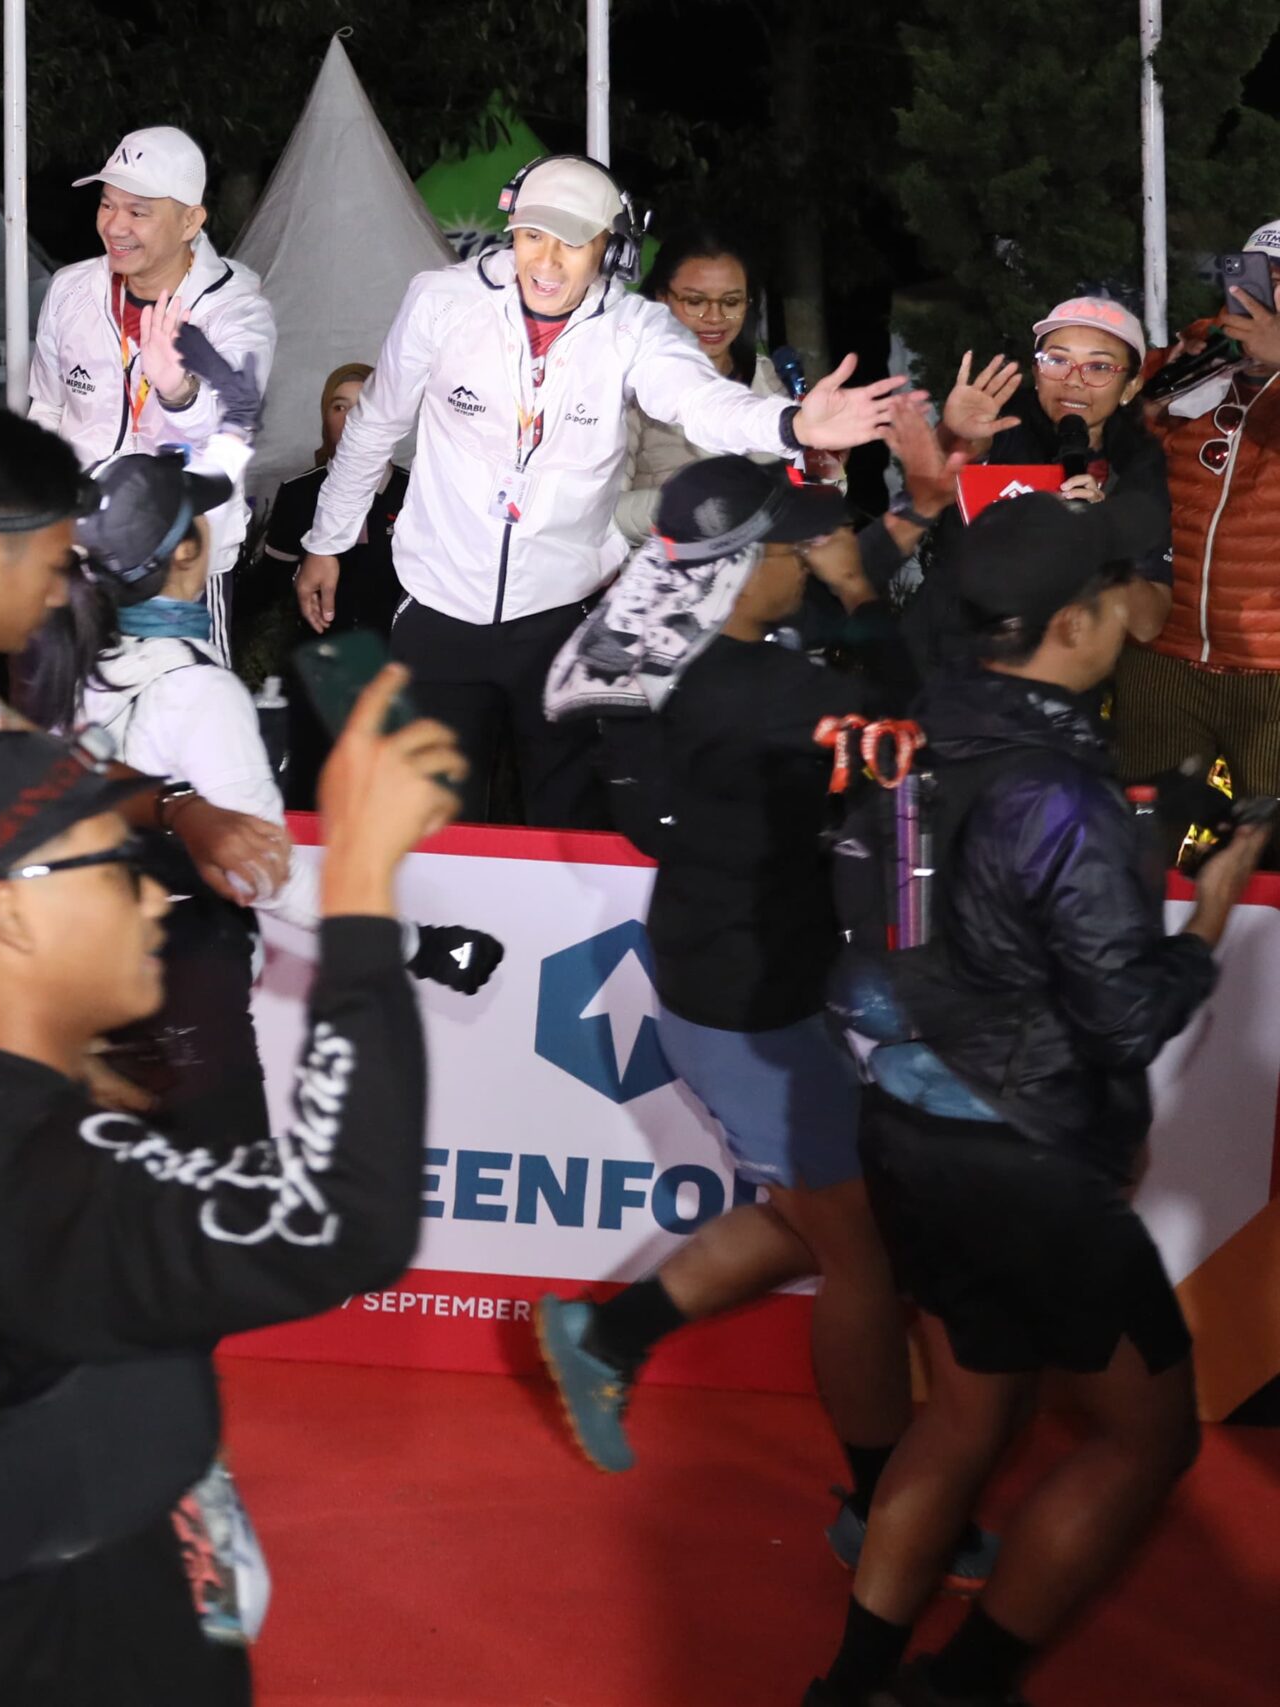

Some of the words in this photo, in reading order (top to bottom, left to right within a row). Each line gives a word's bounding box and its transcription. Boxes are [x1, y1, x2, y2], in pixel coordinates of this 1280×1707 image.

[447, 396, 487, 413] MERBABU
[420, 1147, 771, 1236] ENFO
[362, 1291, 530, 1322] SEPTEMBER
